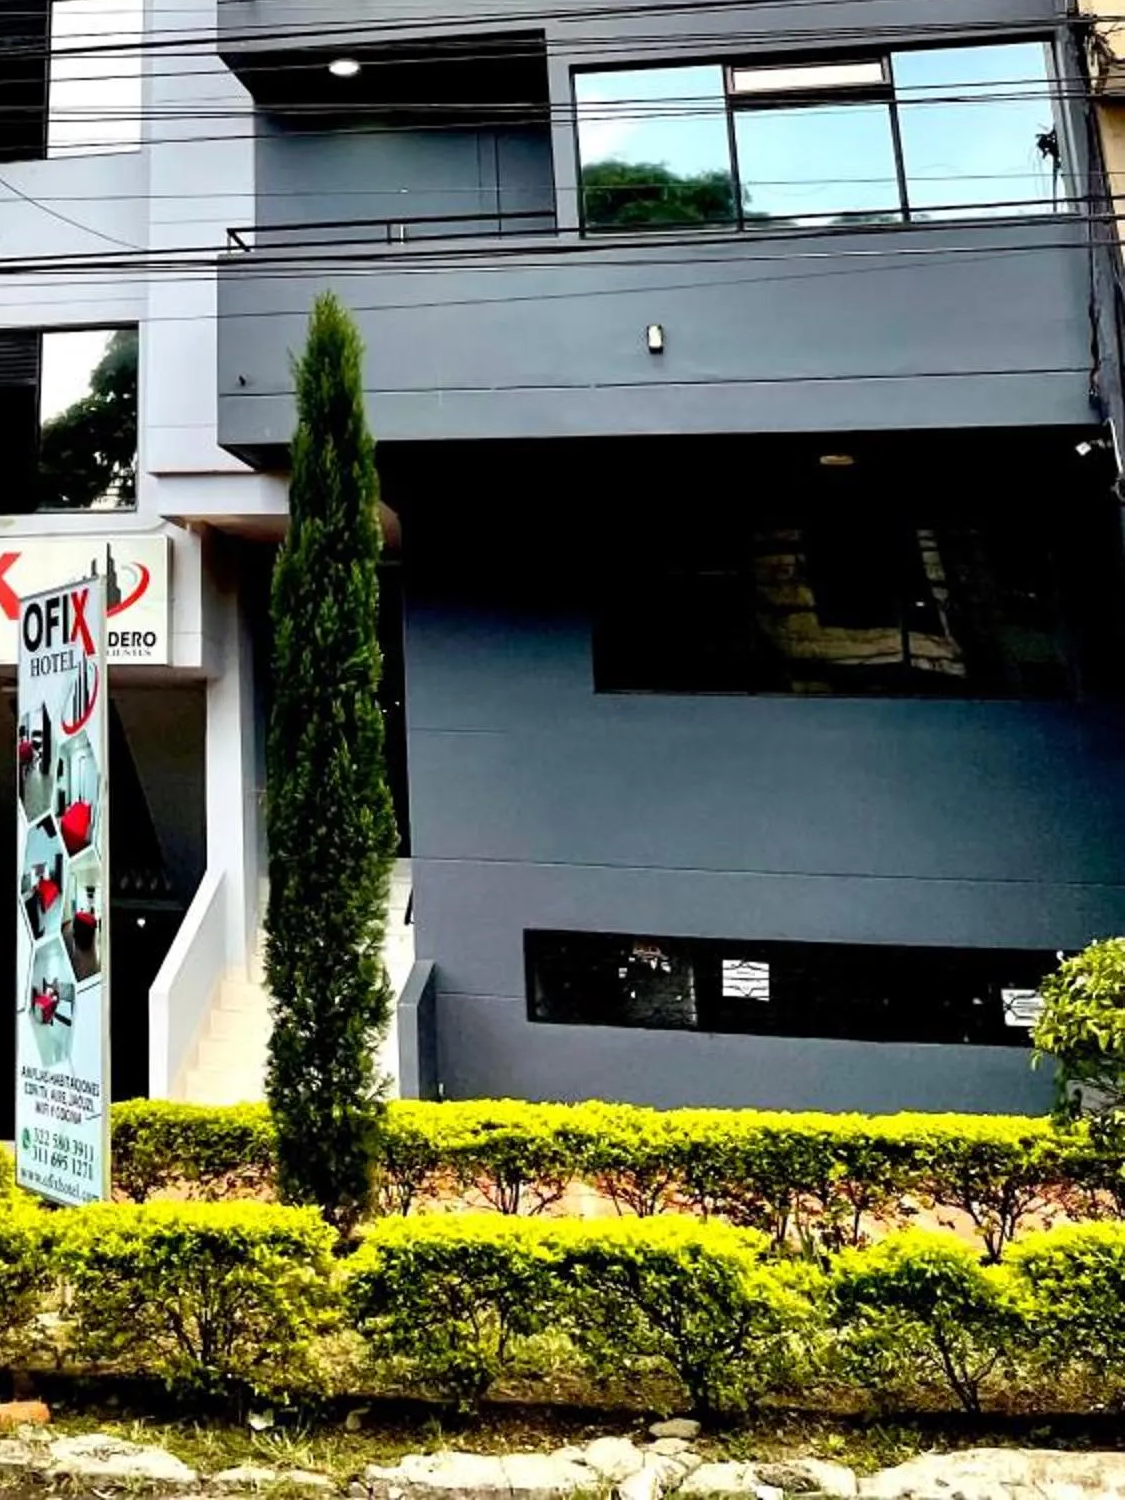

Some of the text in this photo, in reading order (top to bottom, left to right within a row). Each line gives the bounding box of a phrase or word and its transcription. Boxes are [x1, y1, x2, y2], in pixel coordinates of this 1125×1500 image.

[23, 587, 96, 656] OFIX
[108, 631, 157, 647] DERO
[30, 650, 78, 677] HOTEL
[72, 1158, 93, 1181] 1271
